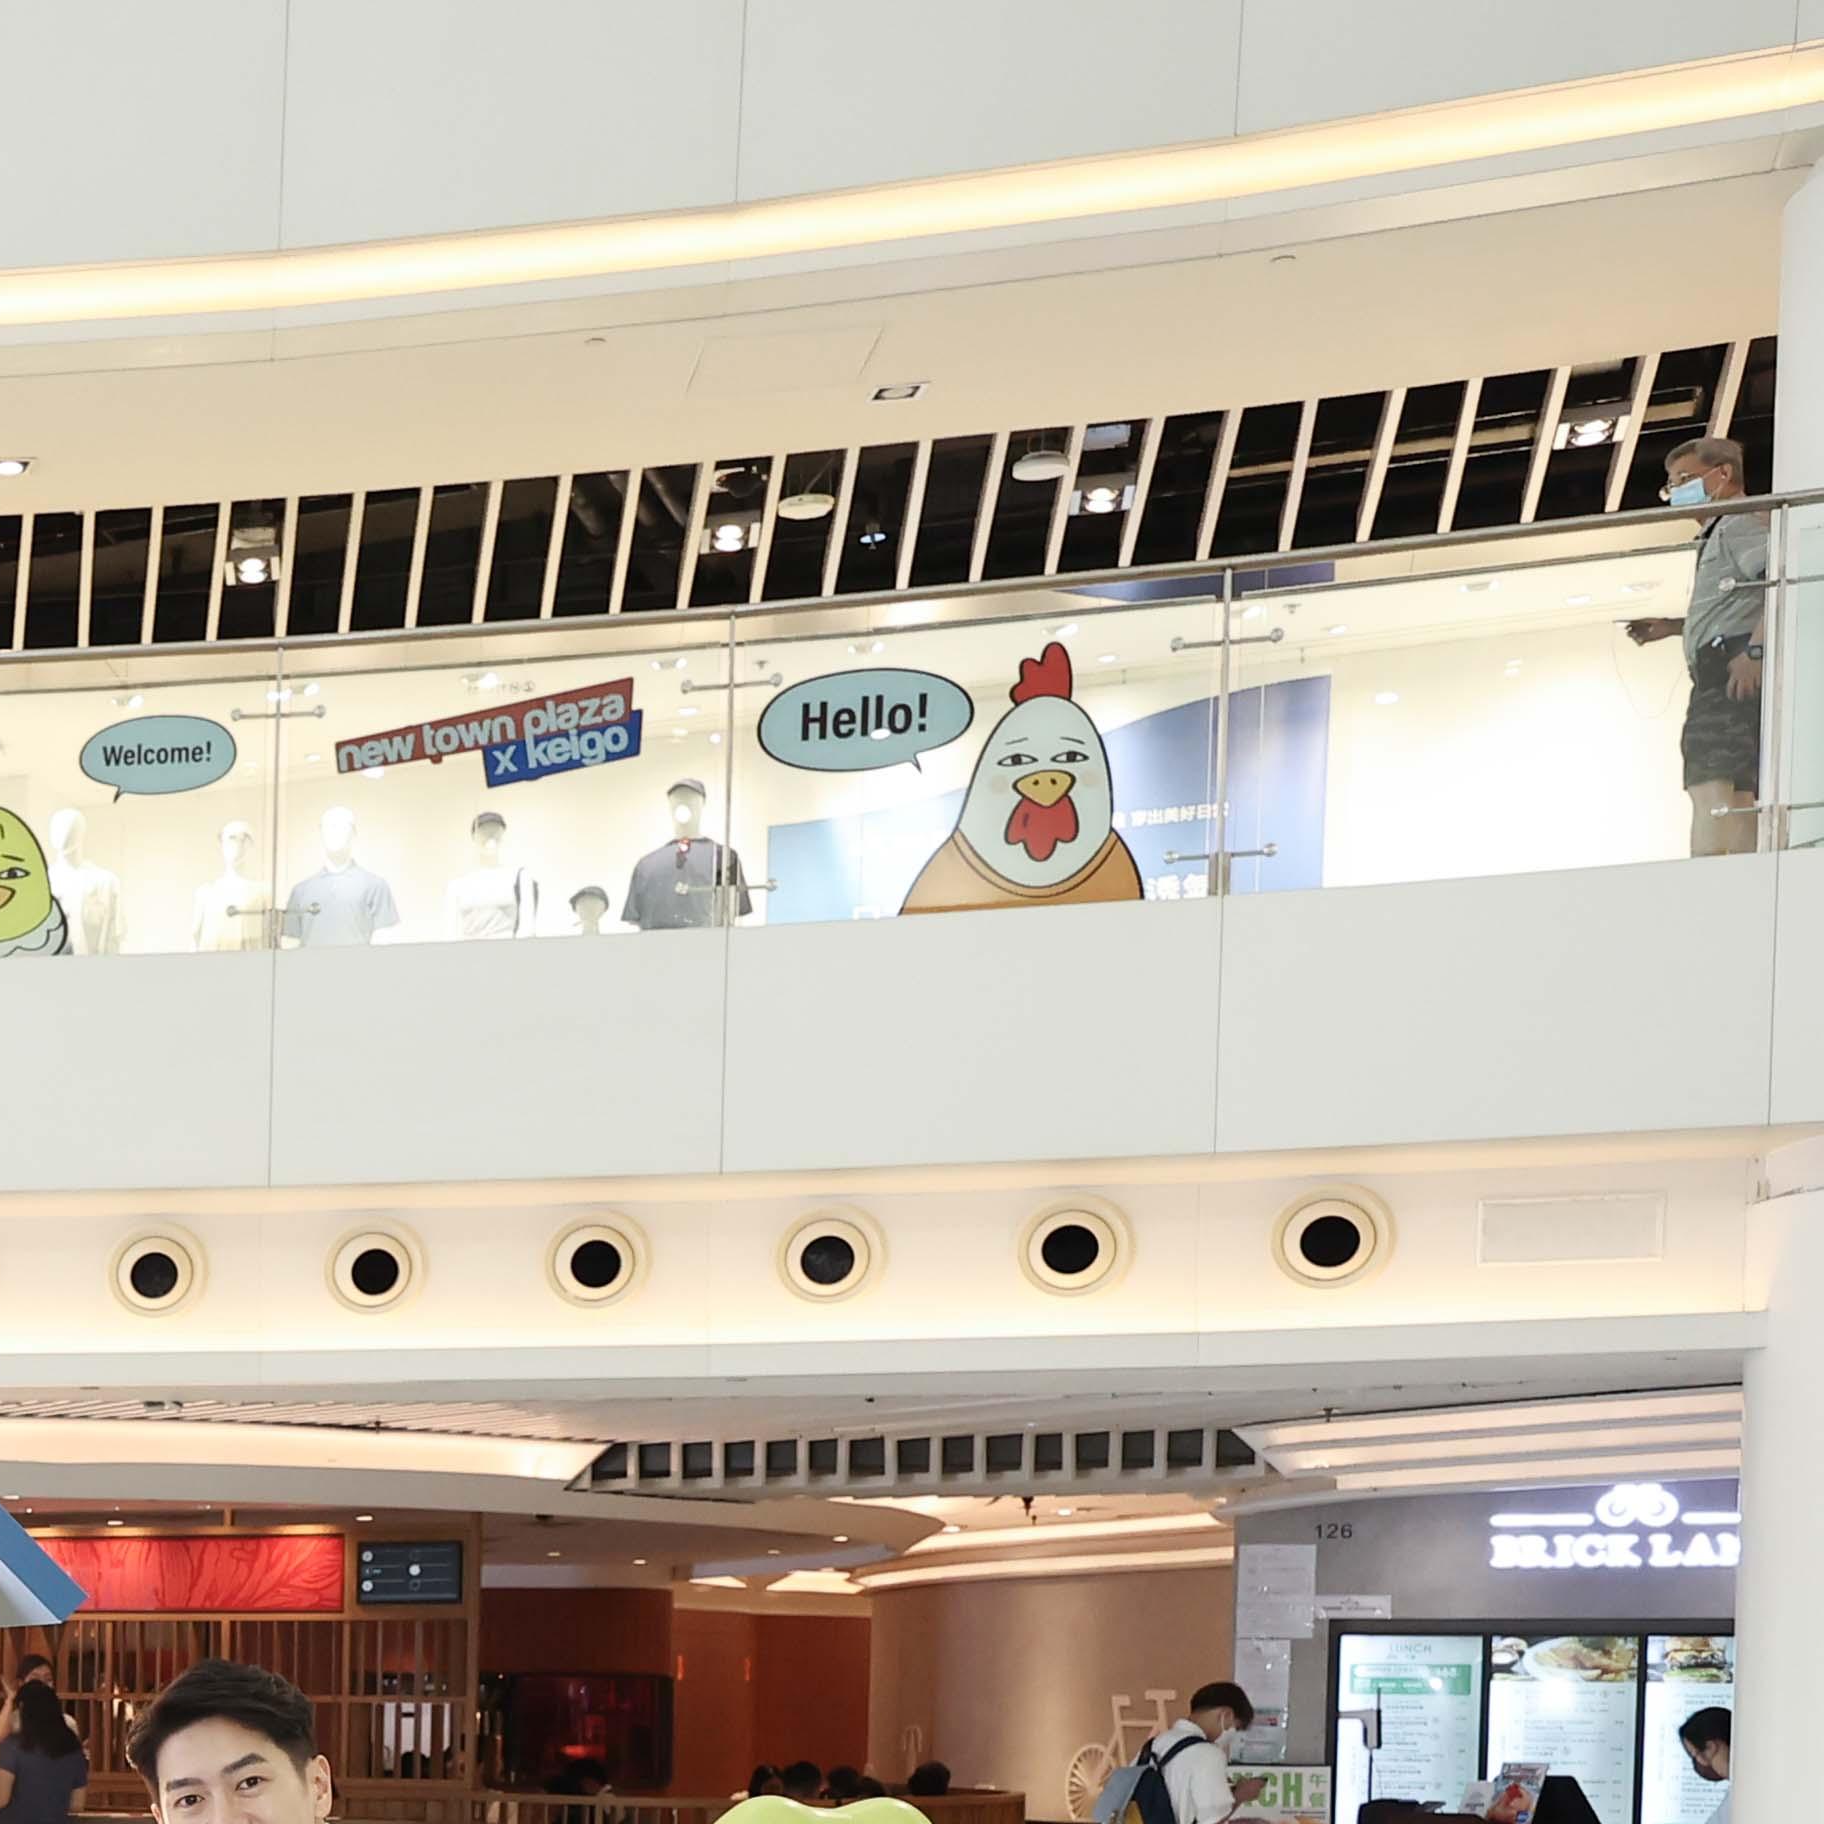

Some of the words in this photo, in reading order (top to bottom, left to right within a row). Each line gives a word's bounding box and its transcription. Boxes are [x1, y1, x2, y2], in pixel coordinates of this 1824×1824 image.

[338, 732, 416, 772] new
[422, 714, 515, 756] town
[523, 693, 625, 740] plaza
[801, 693, 928, 741] Hello!
[102, 741, 212, 767] Welcome!
[494, 744, 517, 775] x
[527, 726, 629, 766] keigo
[1315, 1524, 1353, 1540] 126
[1489, 1534, 1642, 1568] BRICK
